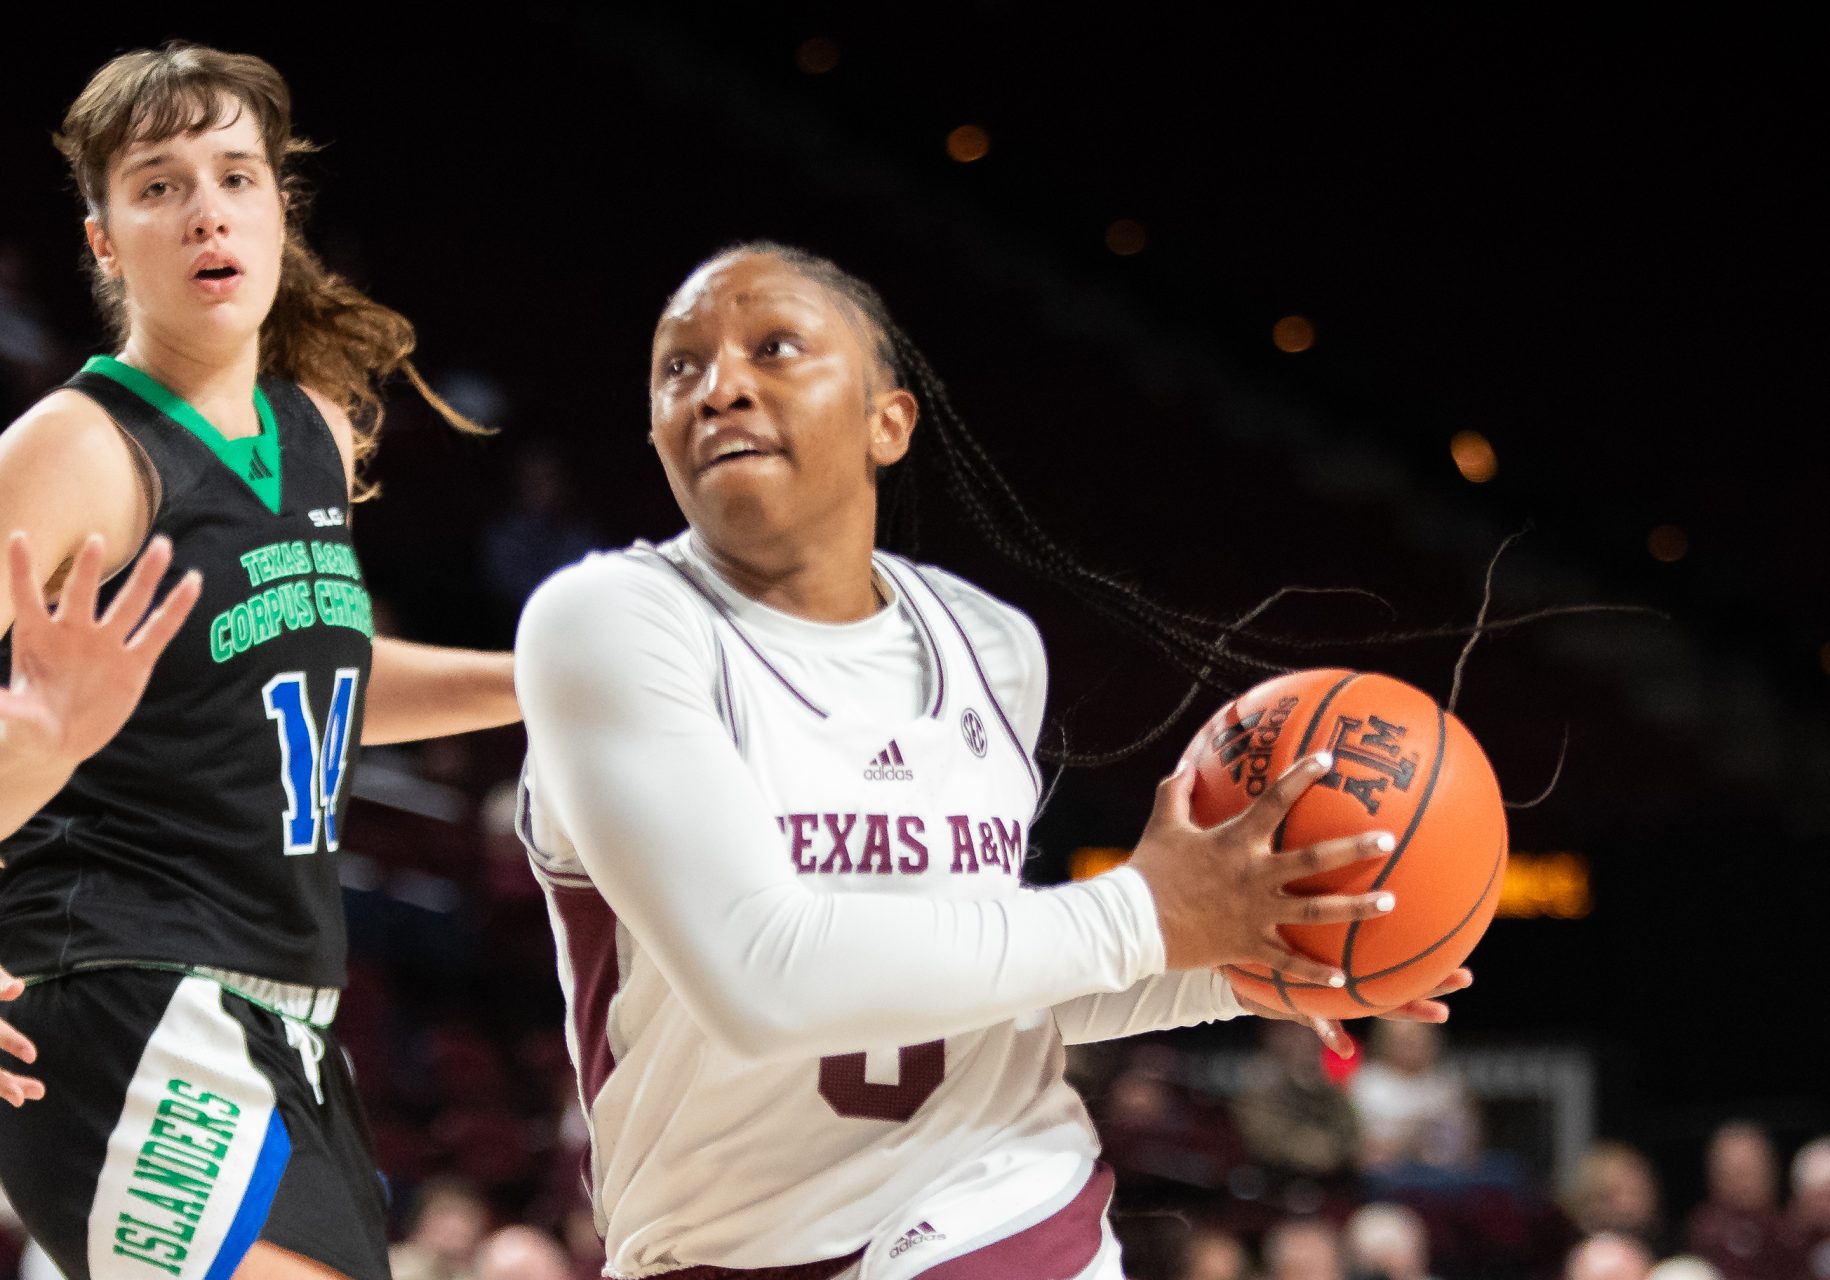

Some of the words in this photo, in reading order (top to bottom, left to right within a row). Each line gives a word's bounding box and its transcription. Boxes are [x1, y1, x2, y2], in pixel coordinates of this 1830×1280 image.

[240, 541, 312, 586] TEXAS
[210, 580, 317, 663] CORPUS
[261, 666, 360, 855] 14
[863, 766, 914, 781] adidas
[945, 814, 1023, 880] A&M
[112, 1078, 241, 1278] ISLANDERS
[889, 1232, 947, 1260] adidas
